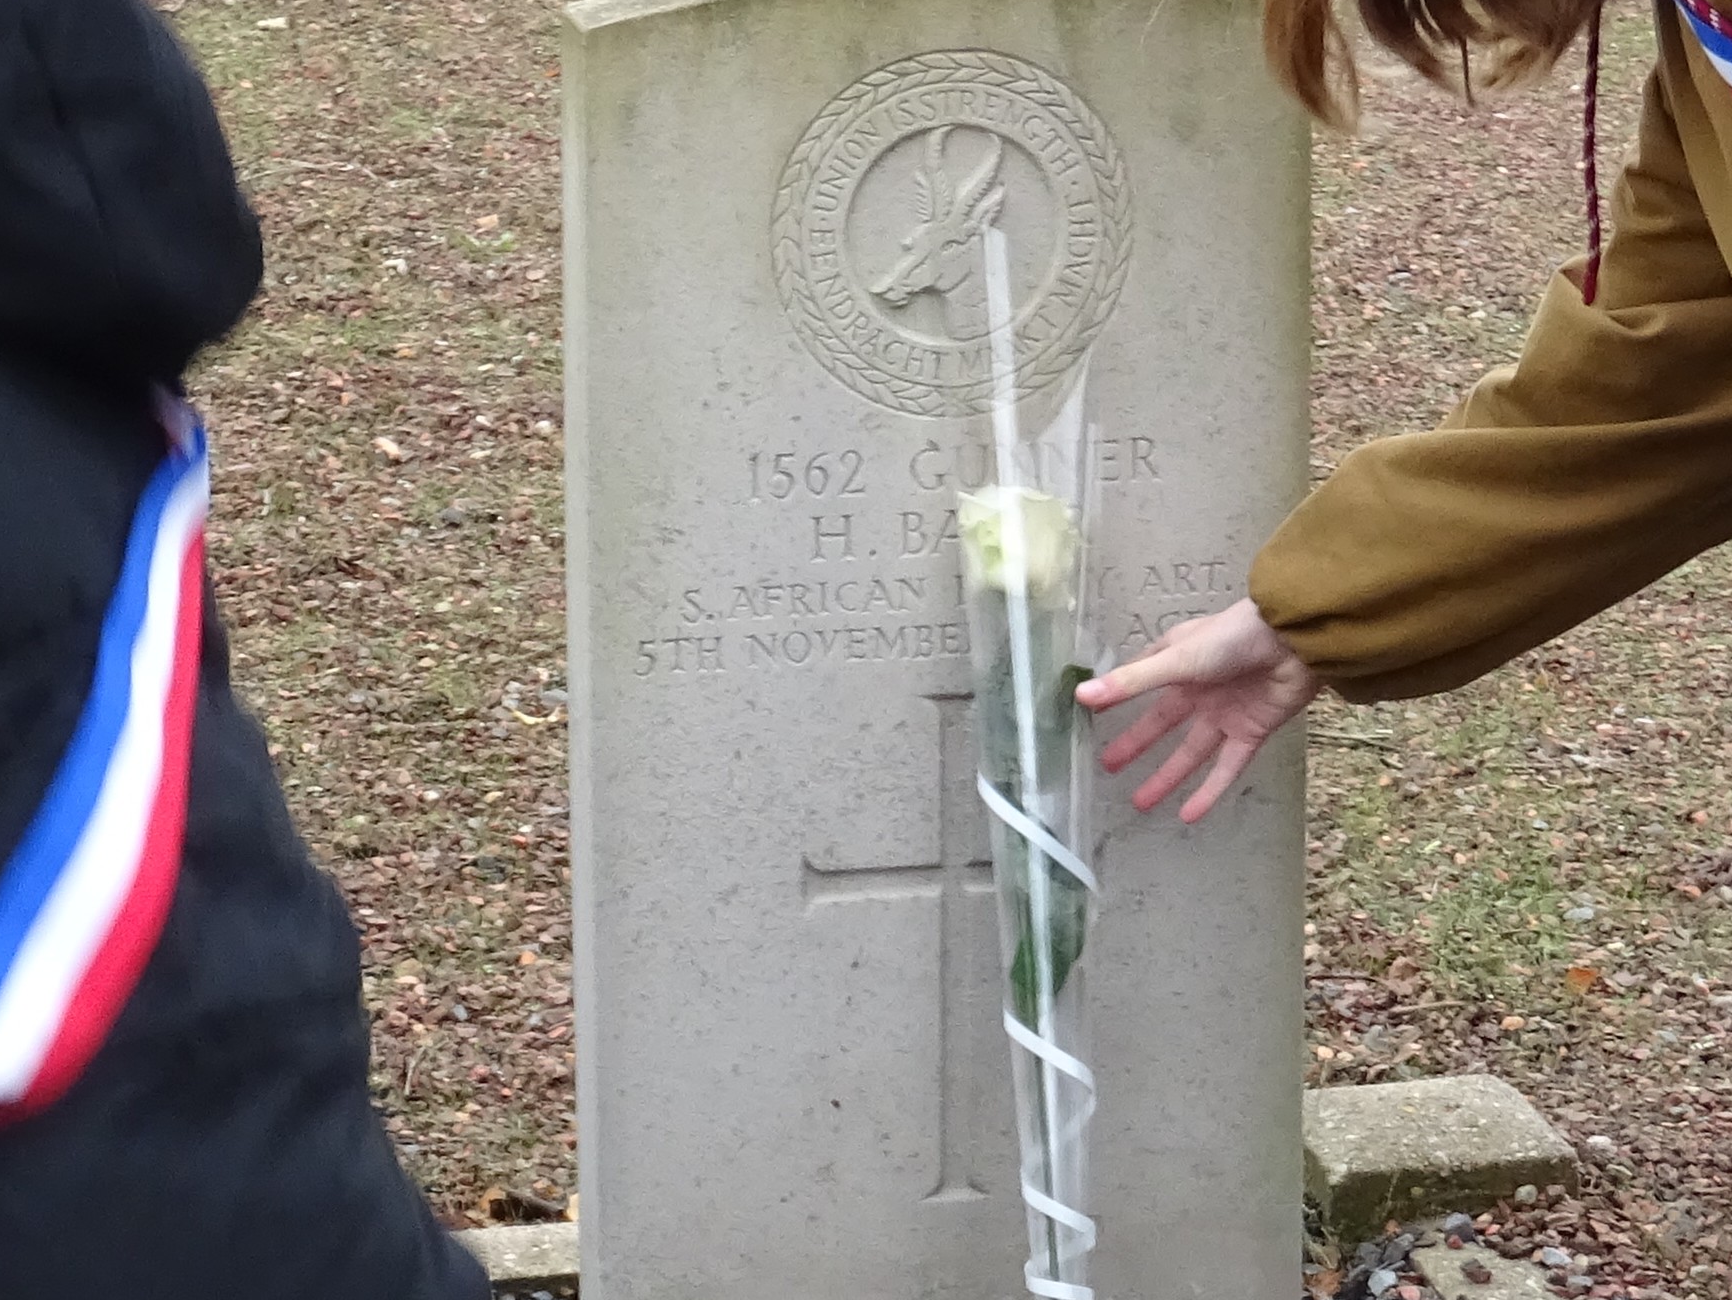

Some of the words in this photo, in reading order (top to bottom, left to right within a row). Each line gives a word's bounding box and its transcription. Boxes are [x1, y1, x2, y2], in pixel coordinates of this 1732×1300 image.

[811, 126, 881, 213] UNION
[883, 99, 917, 127] IS
[918, 89, 1081, 186] STRENGTH
[809, 228, 947, 380] EENDRACHT
[748, 448, 866, 501] 1562
[809, 512, 877, 562] H.
[896, 507, 962, 559] BA
[680, 586, 714, 624] S.
[726, 577, 927, 620] AFRICAN
[1139, 560, 1233, 596] ART.
[633, 635, 725, 677] 5TH
[744, 622, 972, 670] NOVEMBE
